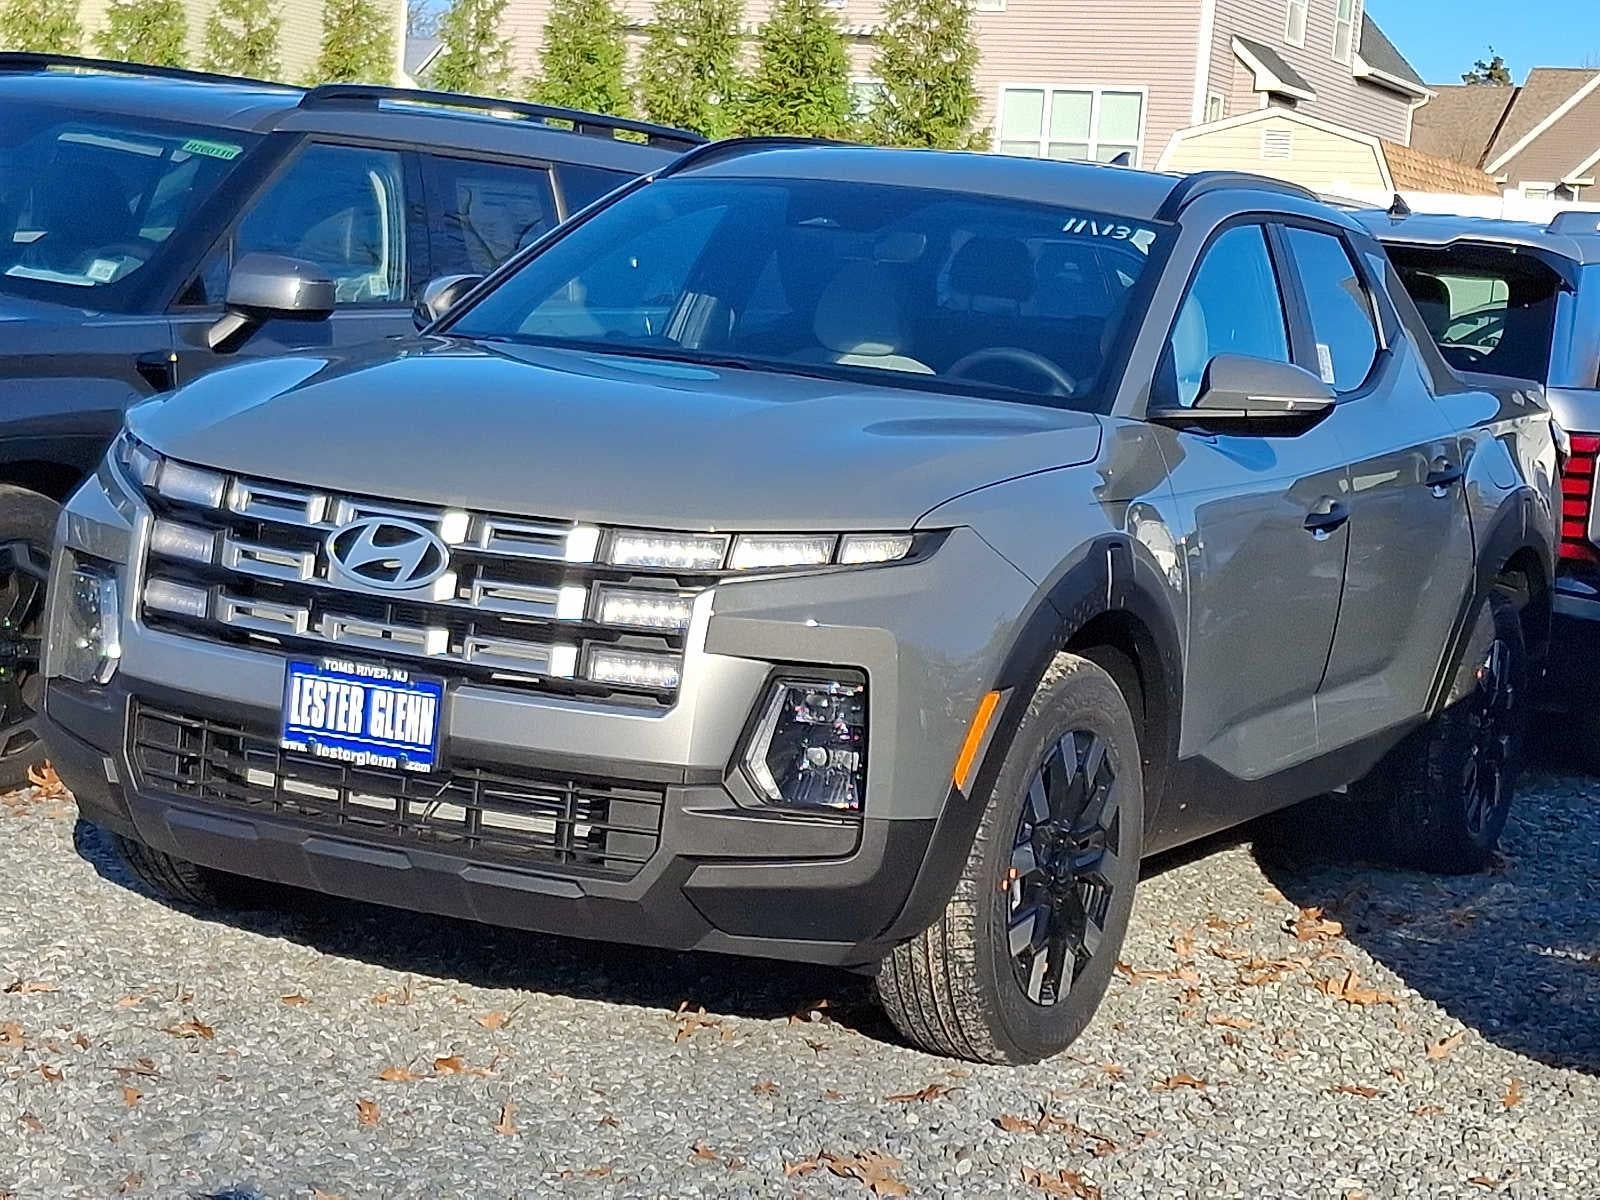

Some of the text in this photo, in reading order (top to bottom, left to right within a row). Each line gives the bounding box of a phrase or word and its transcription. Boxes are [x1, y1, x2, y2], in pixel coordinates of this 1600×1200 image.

[323, 659, 355, 675] TOMS
[392, 669, 409, 682] NJ
[289, 677, 436, 746] LESTER GLENN
